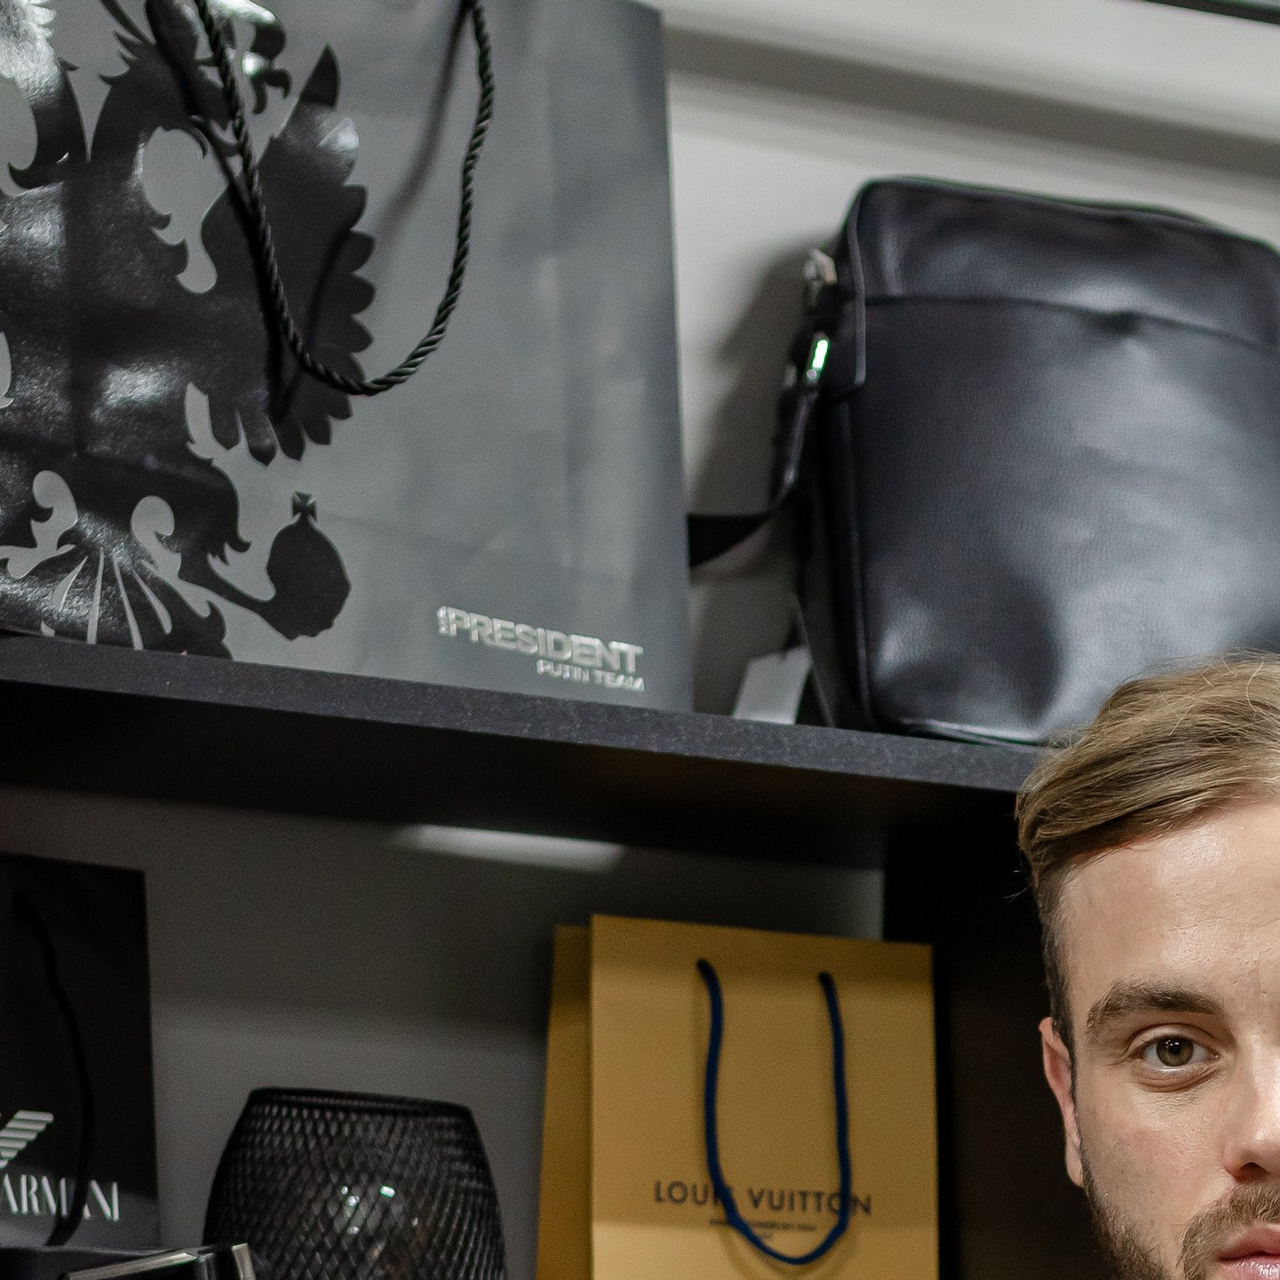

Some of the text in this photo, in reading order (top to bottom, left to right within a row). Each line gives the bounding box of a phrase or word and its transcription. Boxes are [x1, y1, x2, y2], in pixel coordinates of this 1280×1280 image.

[446, 606, 644, 674] PRESIDENT
[536, 659, 645, 692] PUTIN TEAM
